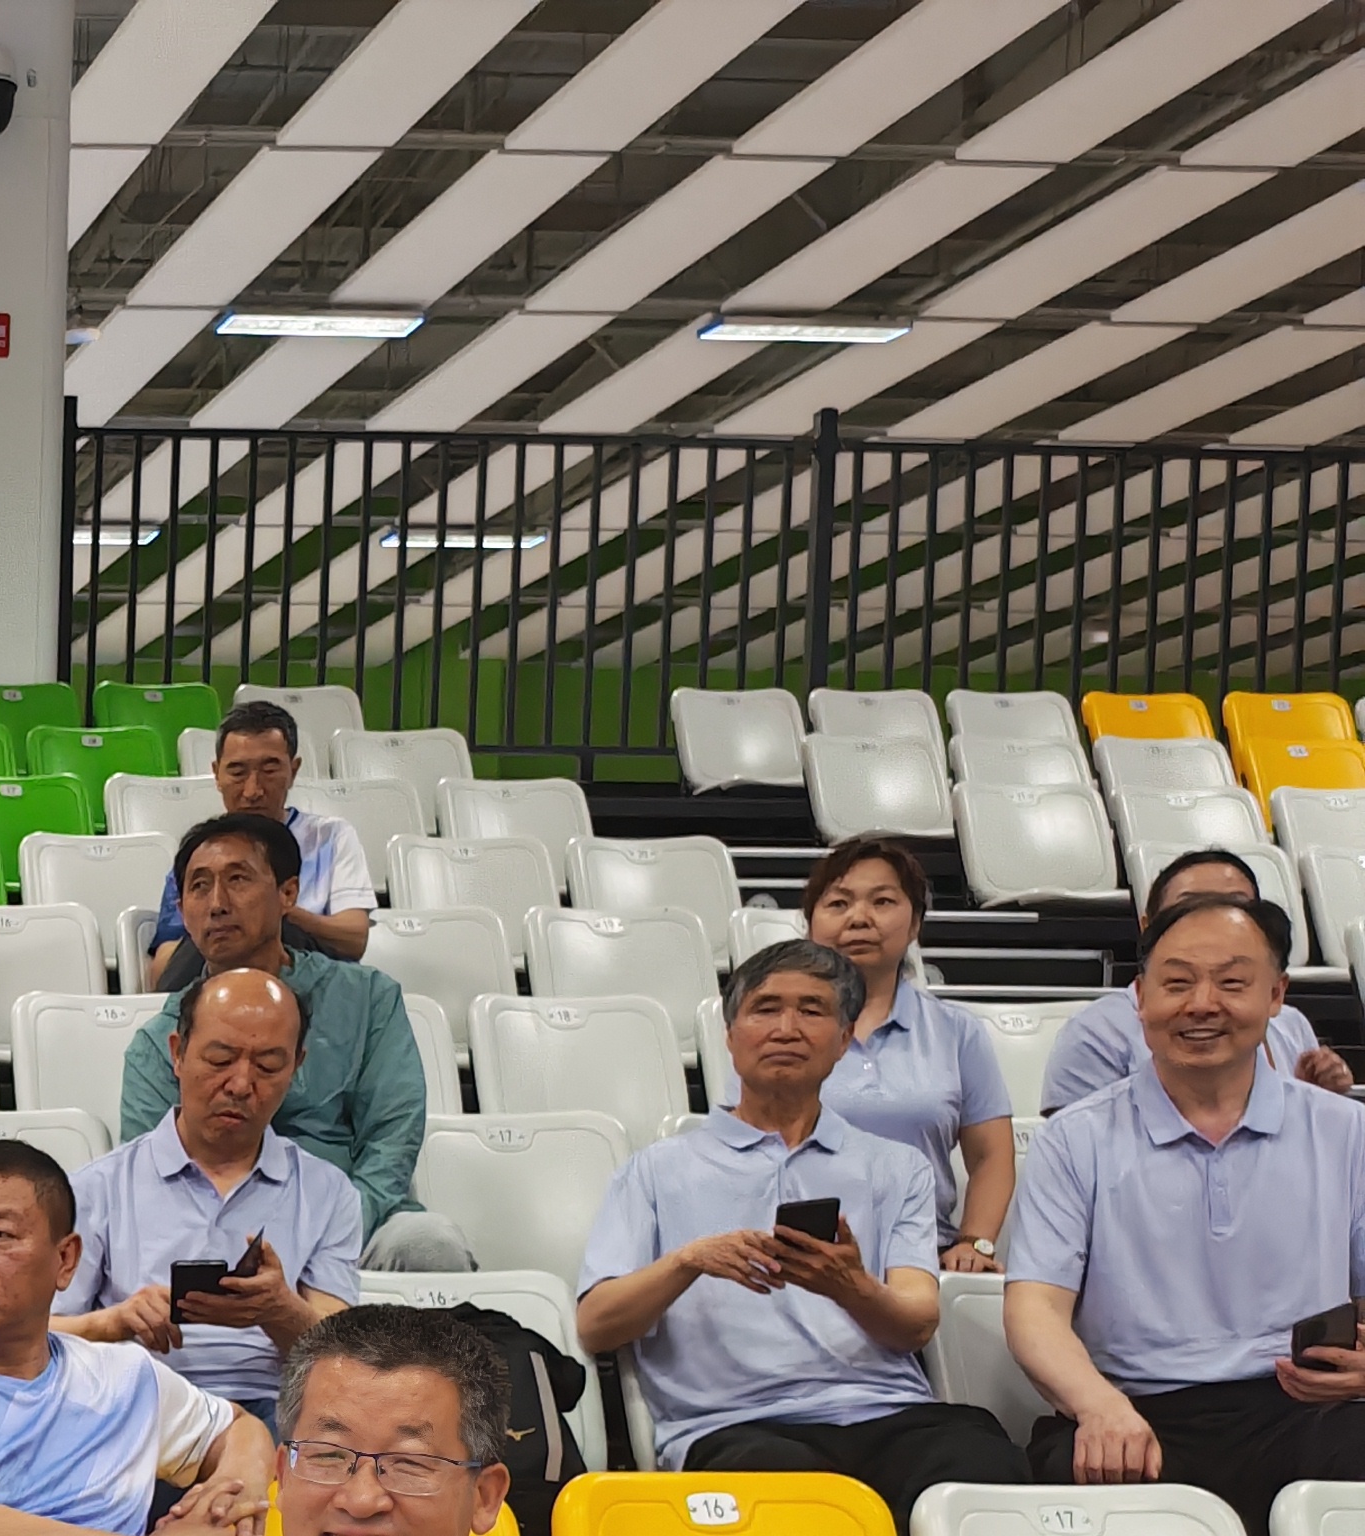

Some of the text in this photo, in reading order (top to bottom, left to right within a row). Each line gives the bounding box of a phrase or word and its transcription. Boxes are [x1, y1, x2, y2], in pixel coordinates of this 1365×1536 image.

[499, 1129, 512, 1143] 17
[429, 1291, 446, 1306] 16
[703, 1499, 724, 1519] 16
[1055, 1510, 1073, 1529] 17
